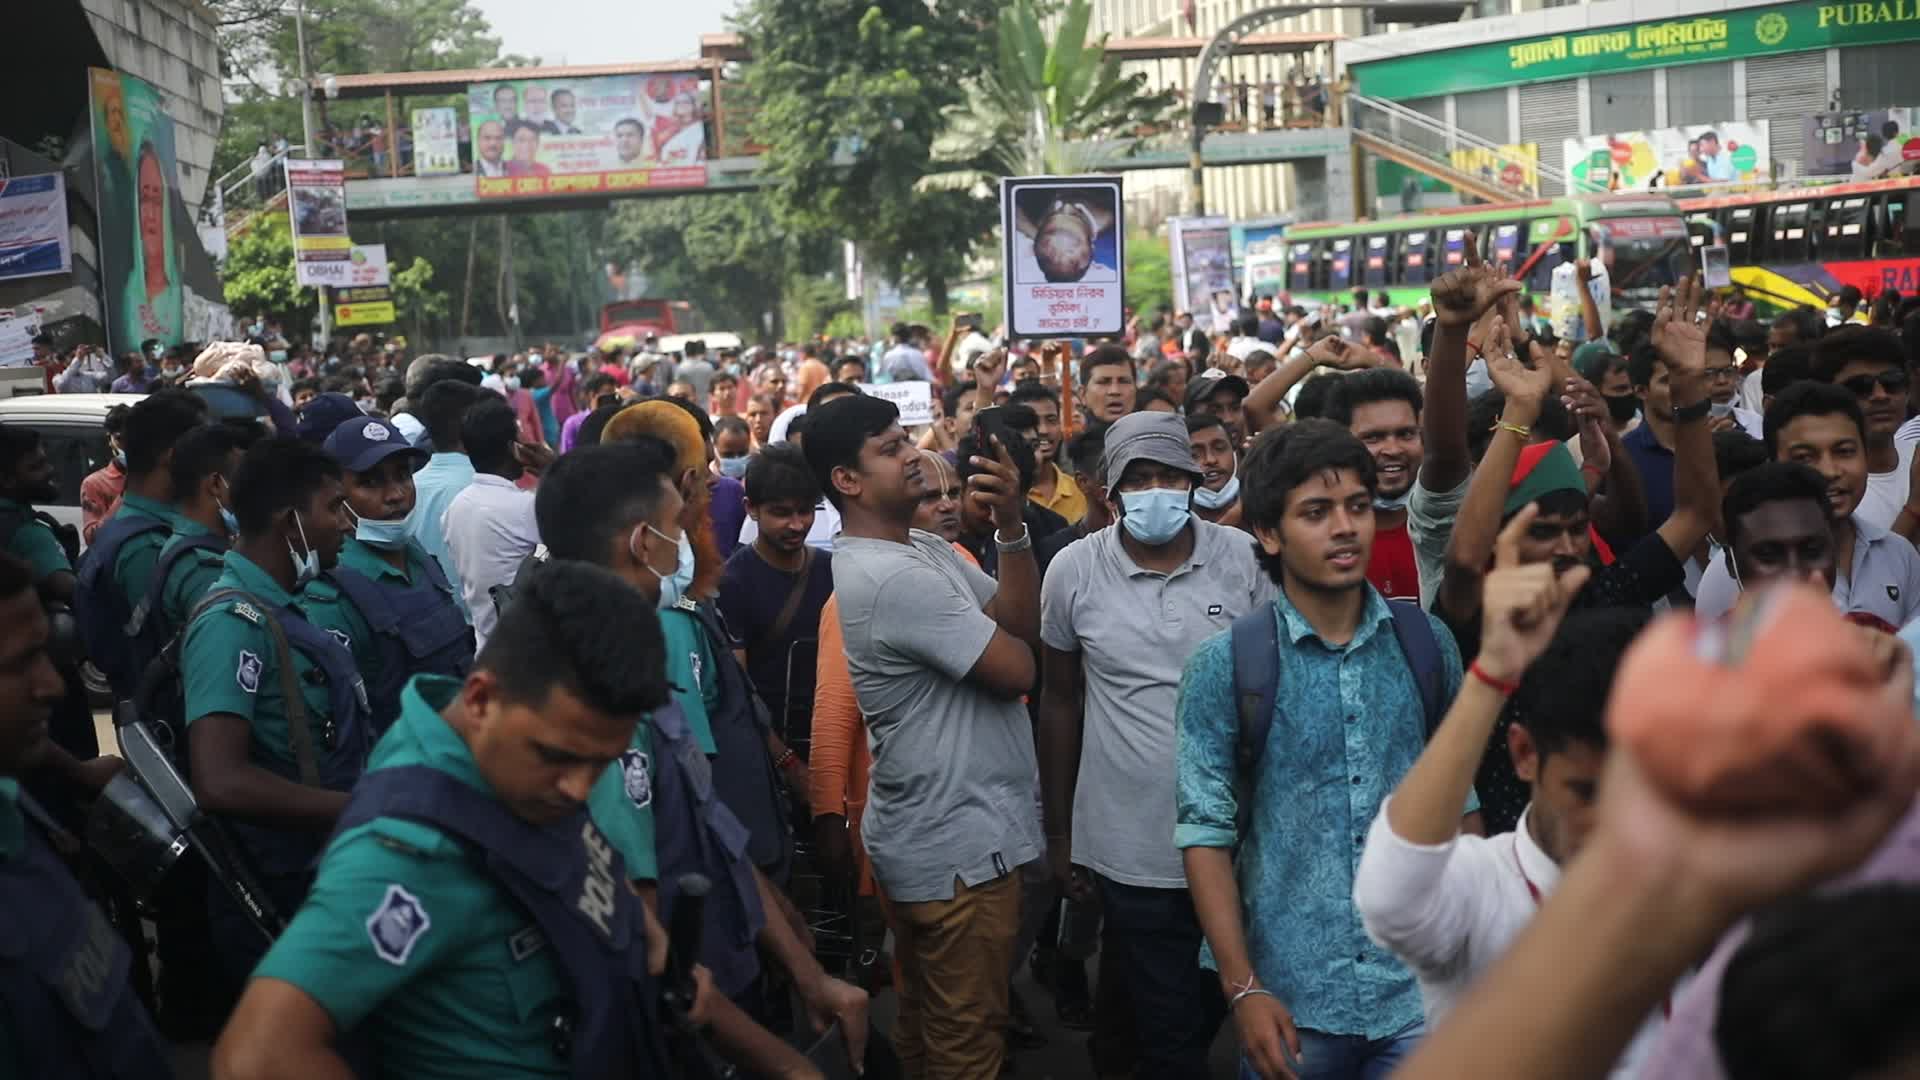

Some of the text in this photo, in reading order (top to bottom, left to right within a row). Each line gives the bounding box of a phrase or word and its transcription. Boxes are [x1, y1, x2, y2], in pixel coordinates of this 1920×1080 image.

[1636, 18, 1728, 49] লিমিটেড
[1882, 267, 1920, 294] RA
[872, 389, 910, 400] Please
